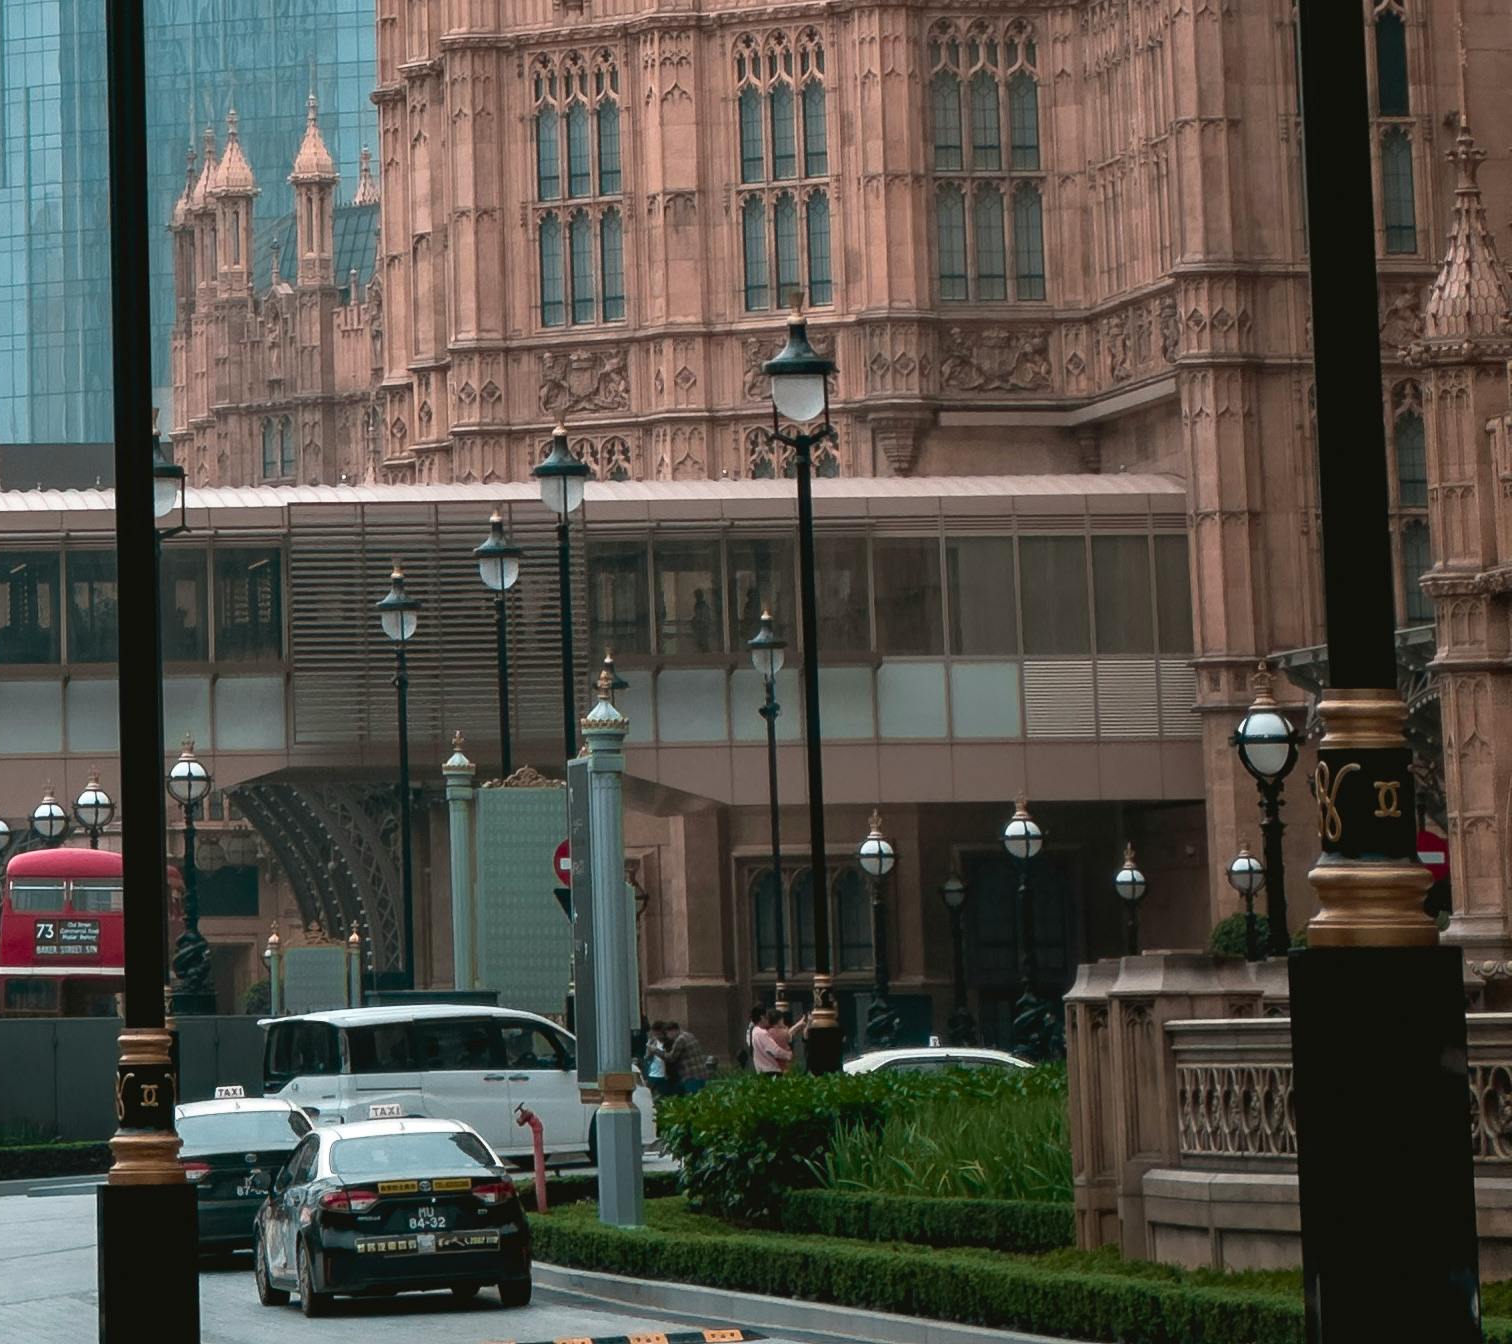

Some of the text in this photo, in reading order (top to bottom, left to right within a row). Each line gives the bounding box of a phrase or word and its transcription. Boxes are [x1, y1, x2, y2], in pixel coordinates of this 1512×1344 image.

[36, 923, 55, 939] 73
[218, 1087, 243, 1098] TAXI
[371, 1105, 402, 1117] TAXI
[418, 1207, 435, 1218] MU
[409, 1218, 446, 1230] 84-32
